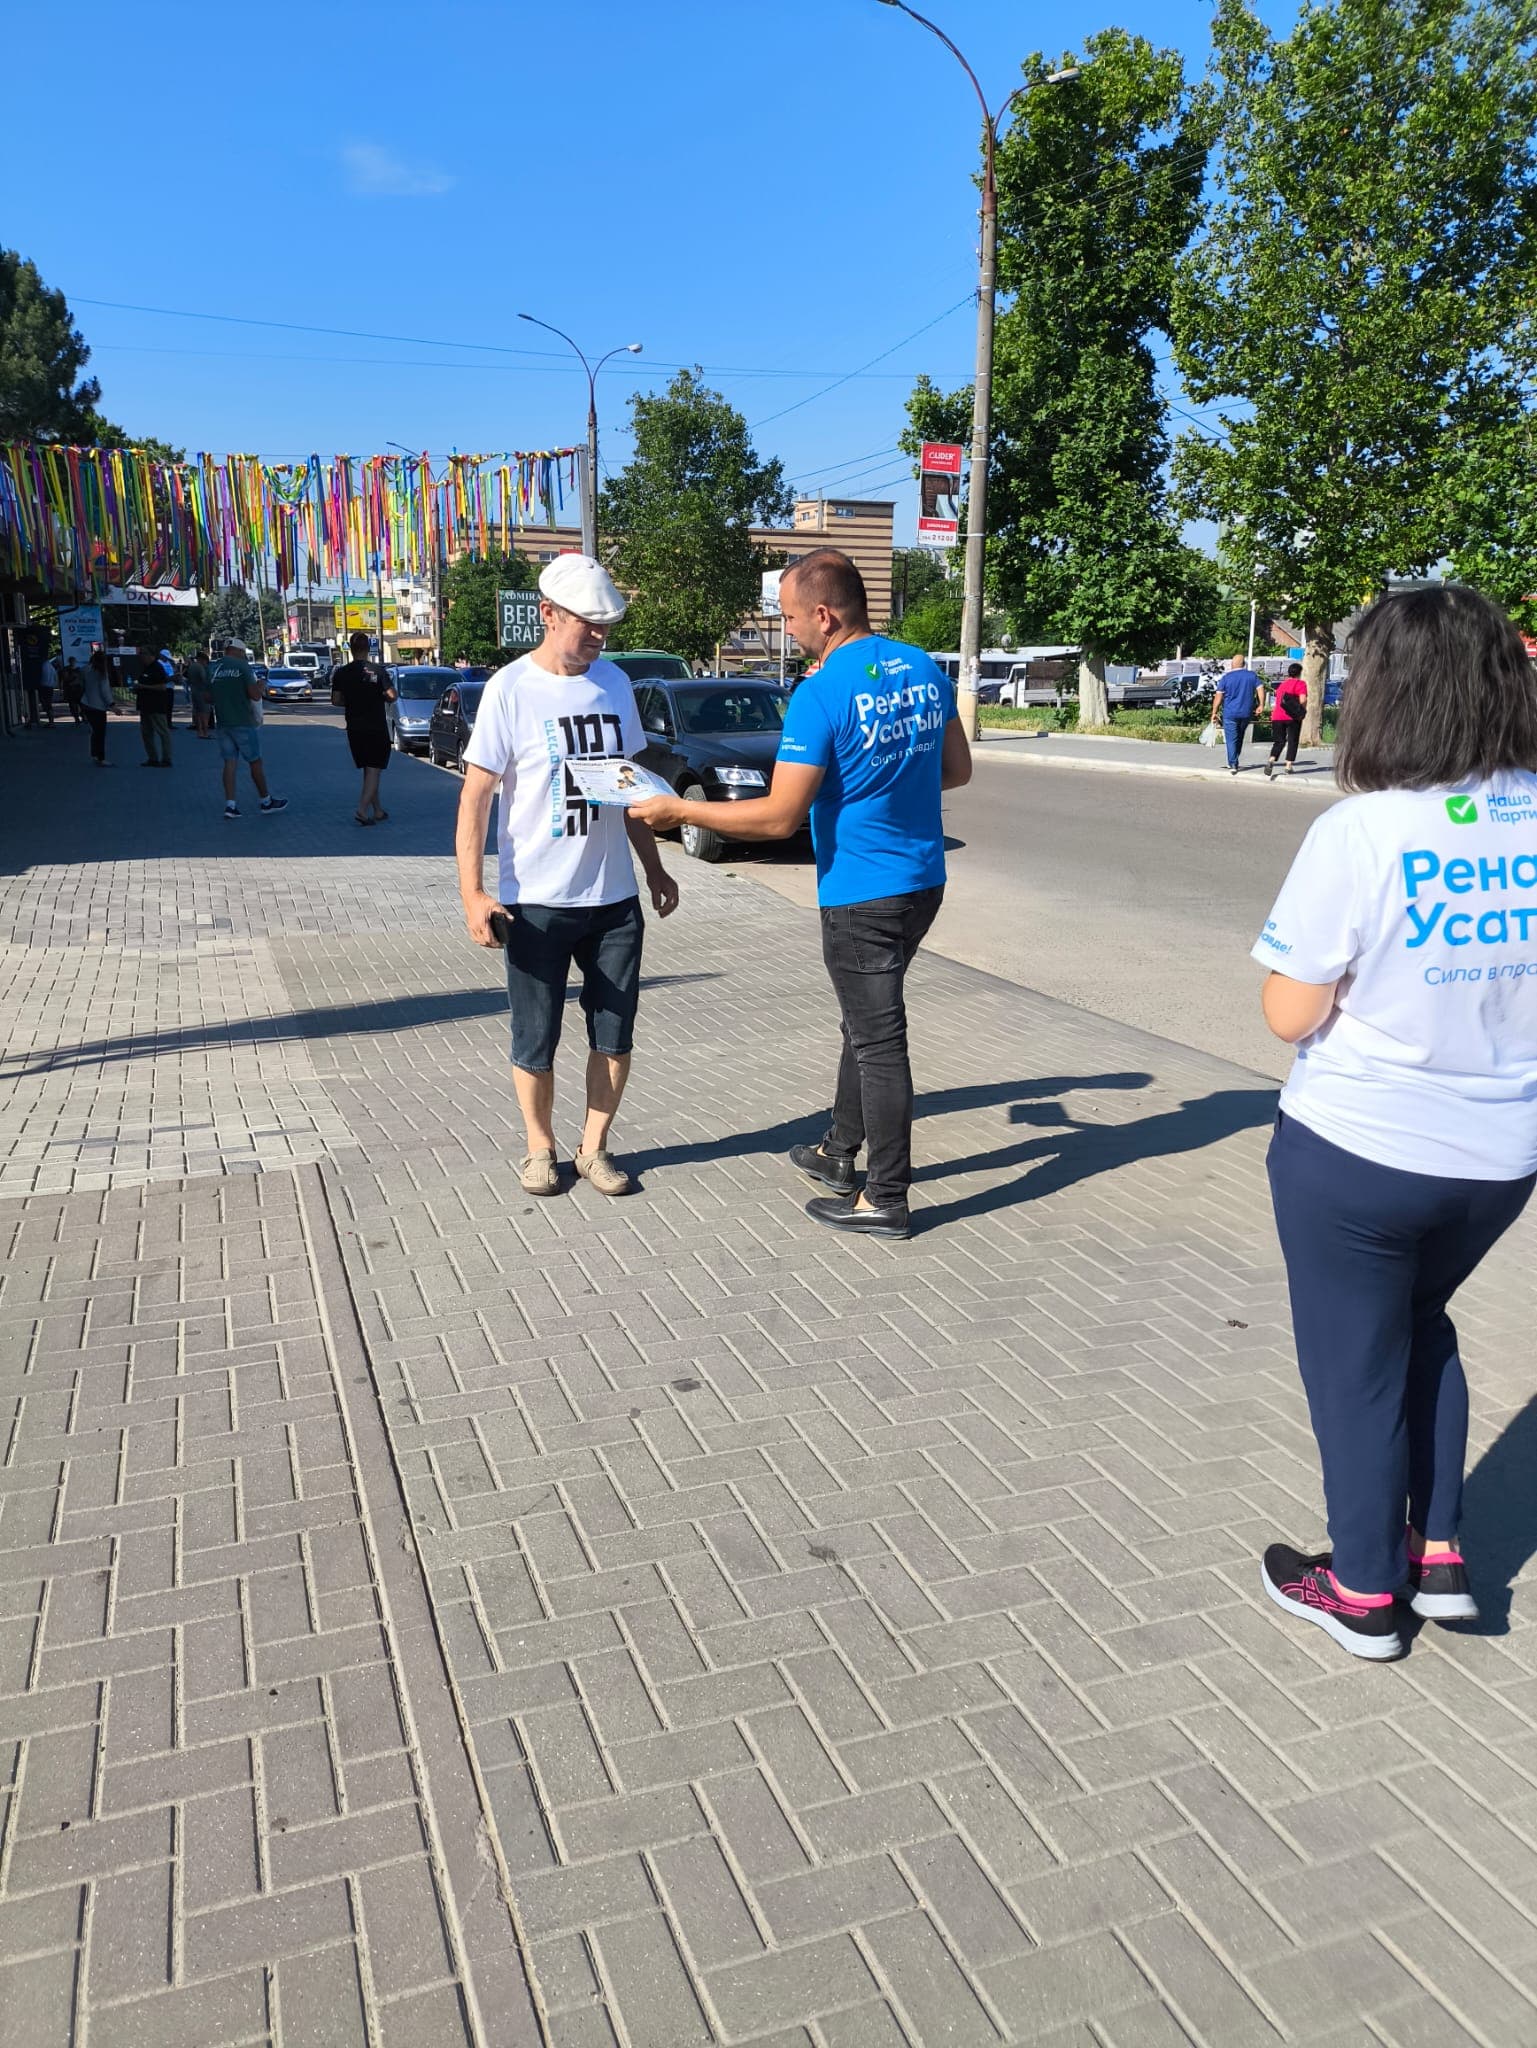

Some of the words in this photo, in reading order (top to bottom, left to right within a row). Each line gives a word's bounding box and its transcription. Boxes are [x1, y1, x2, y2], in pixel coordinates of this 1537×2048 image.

[503, 592, 542, 600] ADMIRA
[855, 682, 940, 721] Ренато
[859, 702, 943, 750] Усатый
[1486, 793, 1532, 807] Наша
[1489, 808, 1537, 826] Парти
[1402, 849, 1537, 898] Рена
[1405, 902, 1537, 949] Усат
[1424, 966, 1482, 985] Сила
[1487, 966, 1497, 980] в
[1500, 963, 1537, 980] пра
